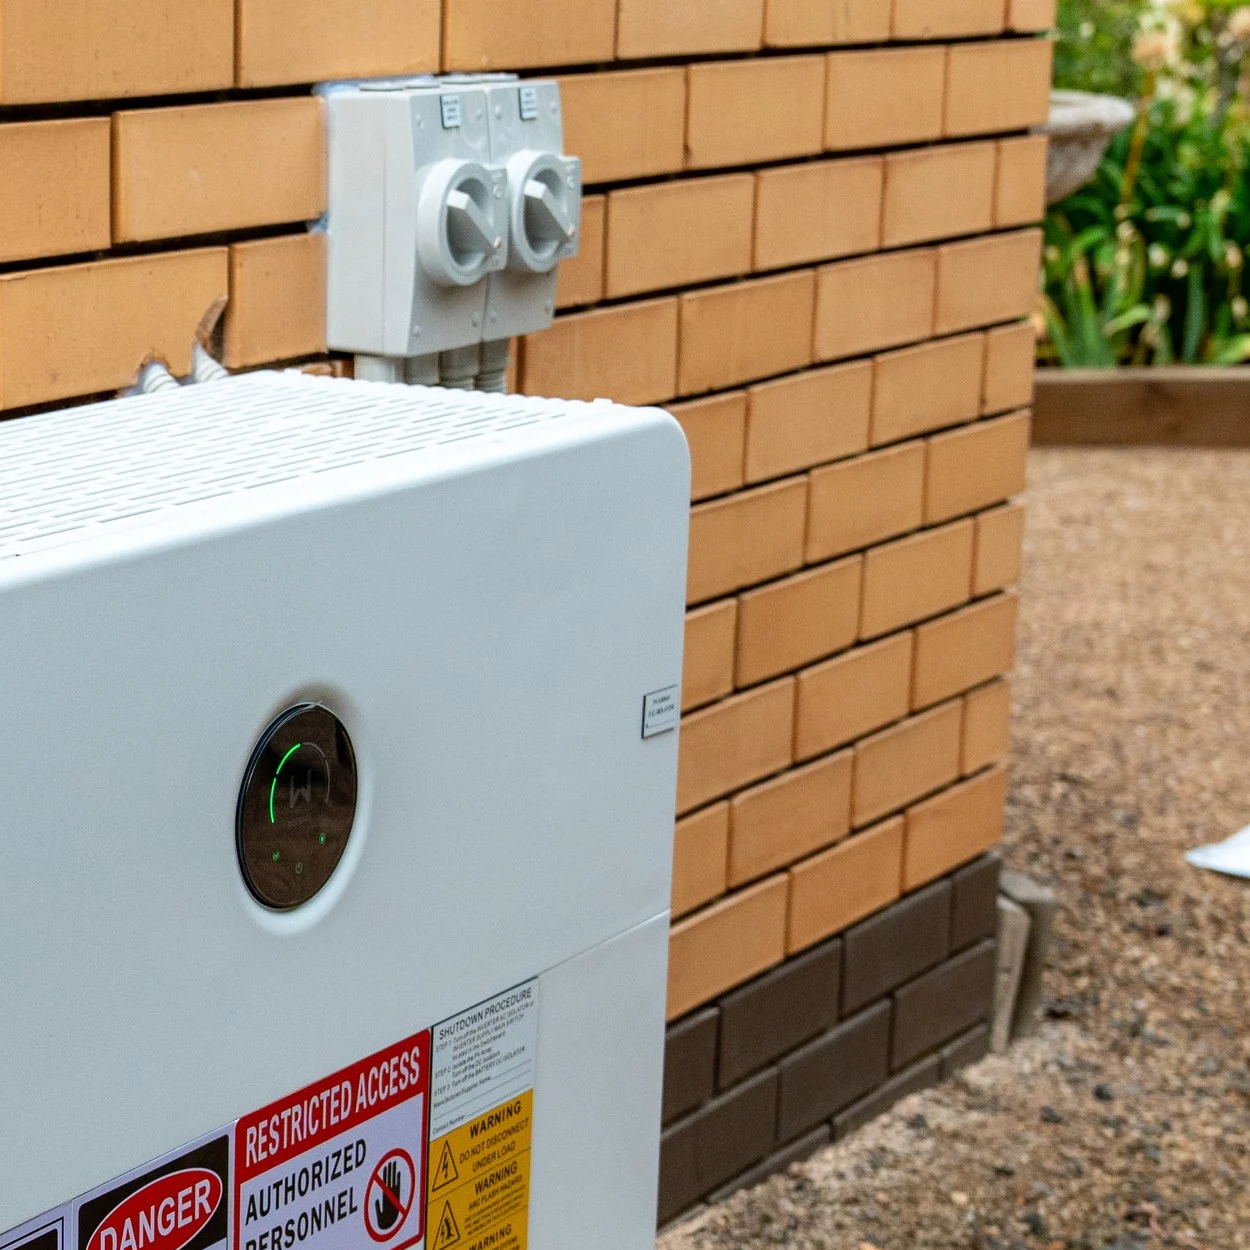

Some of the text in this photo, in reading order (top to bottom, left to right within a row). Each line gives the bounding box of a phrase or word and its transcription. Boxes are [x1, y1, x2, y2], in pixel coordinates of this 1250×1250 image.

[439, 986, 531, 1041] SHUTDOWN PROCEDURE
[245, 1046, 420, 1168] RESTRICTED ACCESS
[470, 1100, 521, 1139] WARNING
[460, 1117, 529, 1164] DO NOT DISCONNECT
[473, 1140, 515, 1173] UNDER LOAD
[245, 1138, 367, 1226] AUTHORIZED
[474, 1160, 517, 1196] WARNING
